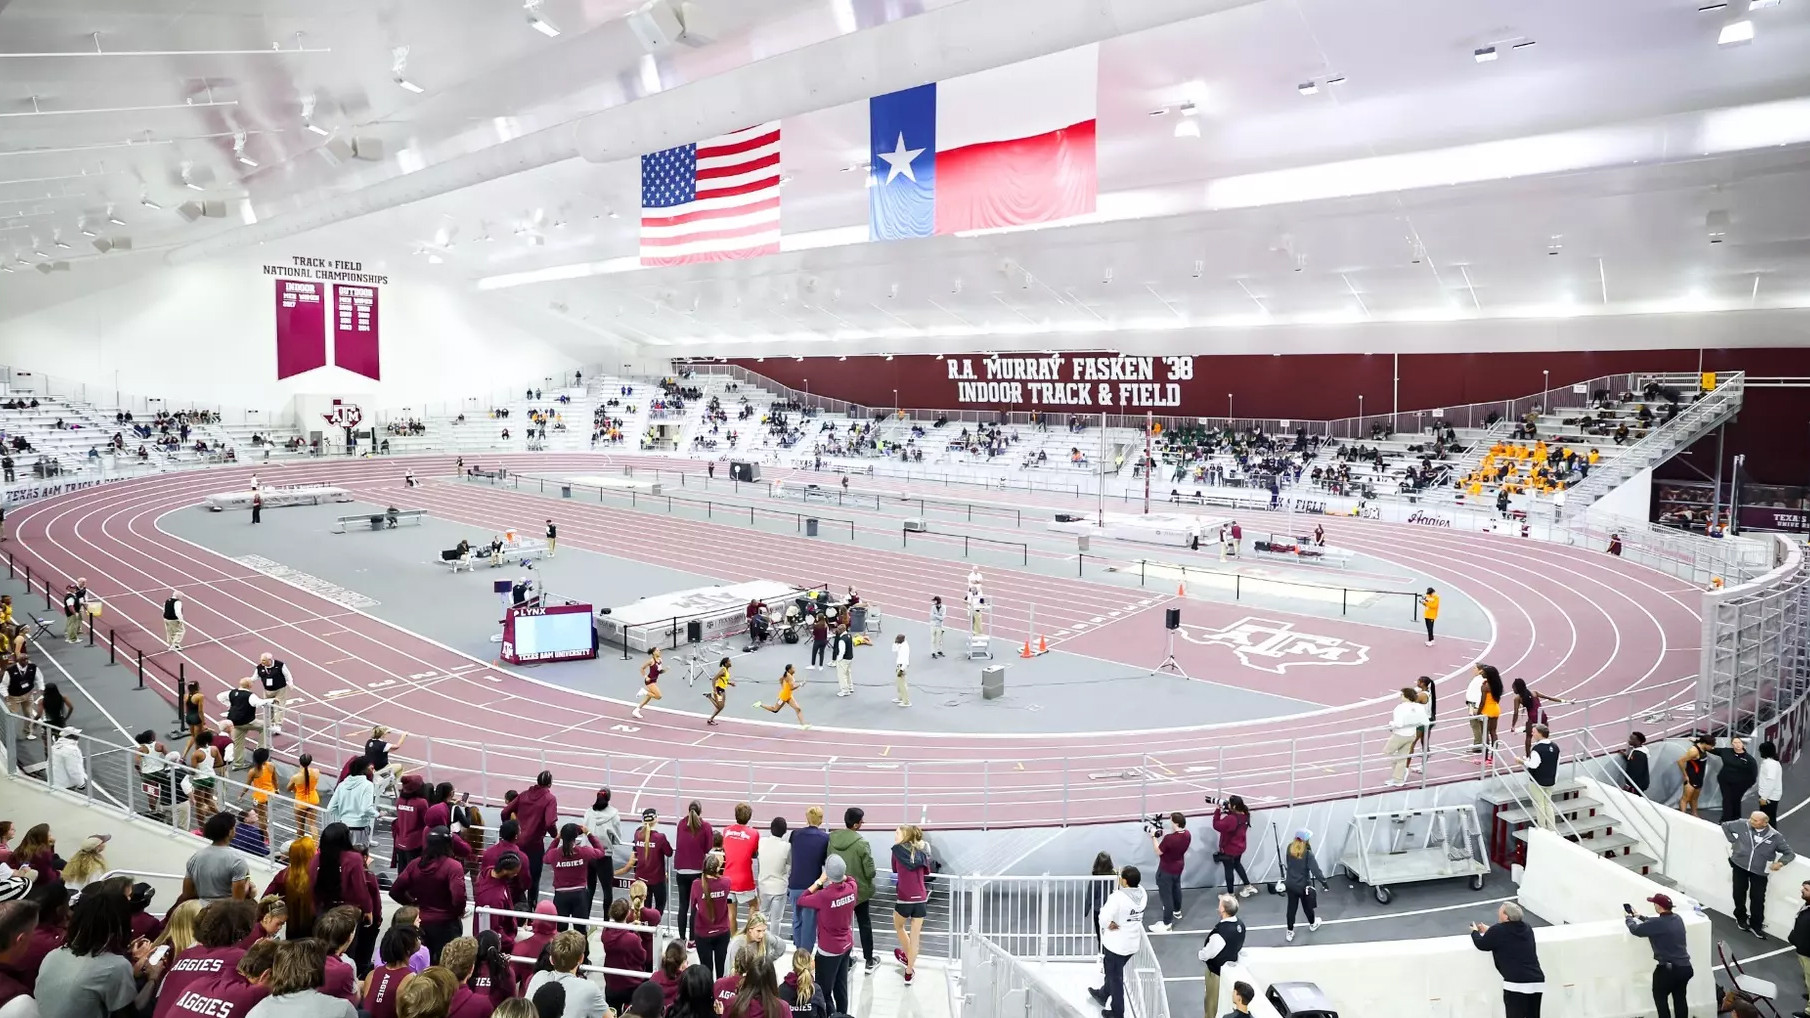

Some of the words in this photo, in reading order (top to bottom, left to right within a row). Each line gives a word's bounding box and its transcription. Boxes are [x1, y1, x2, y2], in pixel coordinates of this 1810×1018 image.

[292, 256, 325, 268] TRACK
[335, 260, 361, 271] FIELD
[263, 265, 312, 278] NATIONAL
[315, 270, 388, 284] CHAMPIONSHIPS
[286, 282, 315, 292] INDOOR
[339, 286, 373, 296] OUTDOOR
[947, 358, 978, 380] R.A.
[1072, 357, 1154, 380] FASKEN
[1162, 356, 1194, 380] '38
[958, 382, 1023, 403] INDOOR
[1028, 382, 1092, 405] TRACK
[1098, 383, 1113, 406] &
[1119, 383, 1180, 406] FIELD
[6, 488, 38, 502] TEXAS
[42, 485, 62, 498] A&M
[521, 608, 546, 616] LYNX
[540, 651, 554, 659] A&M
[554, 648, 590, 658] UNIVERSITY
[556, 859, 584, 868] AGGIES
[831, 894, 855, 908] AGGIES
[171, 958, 224, 972] AGGIES
[376, 974, 390, 1004] AGGIES
[176, 991, 234, 1018] AGGIES
